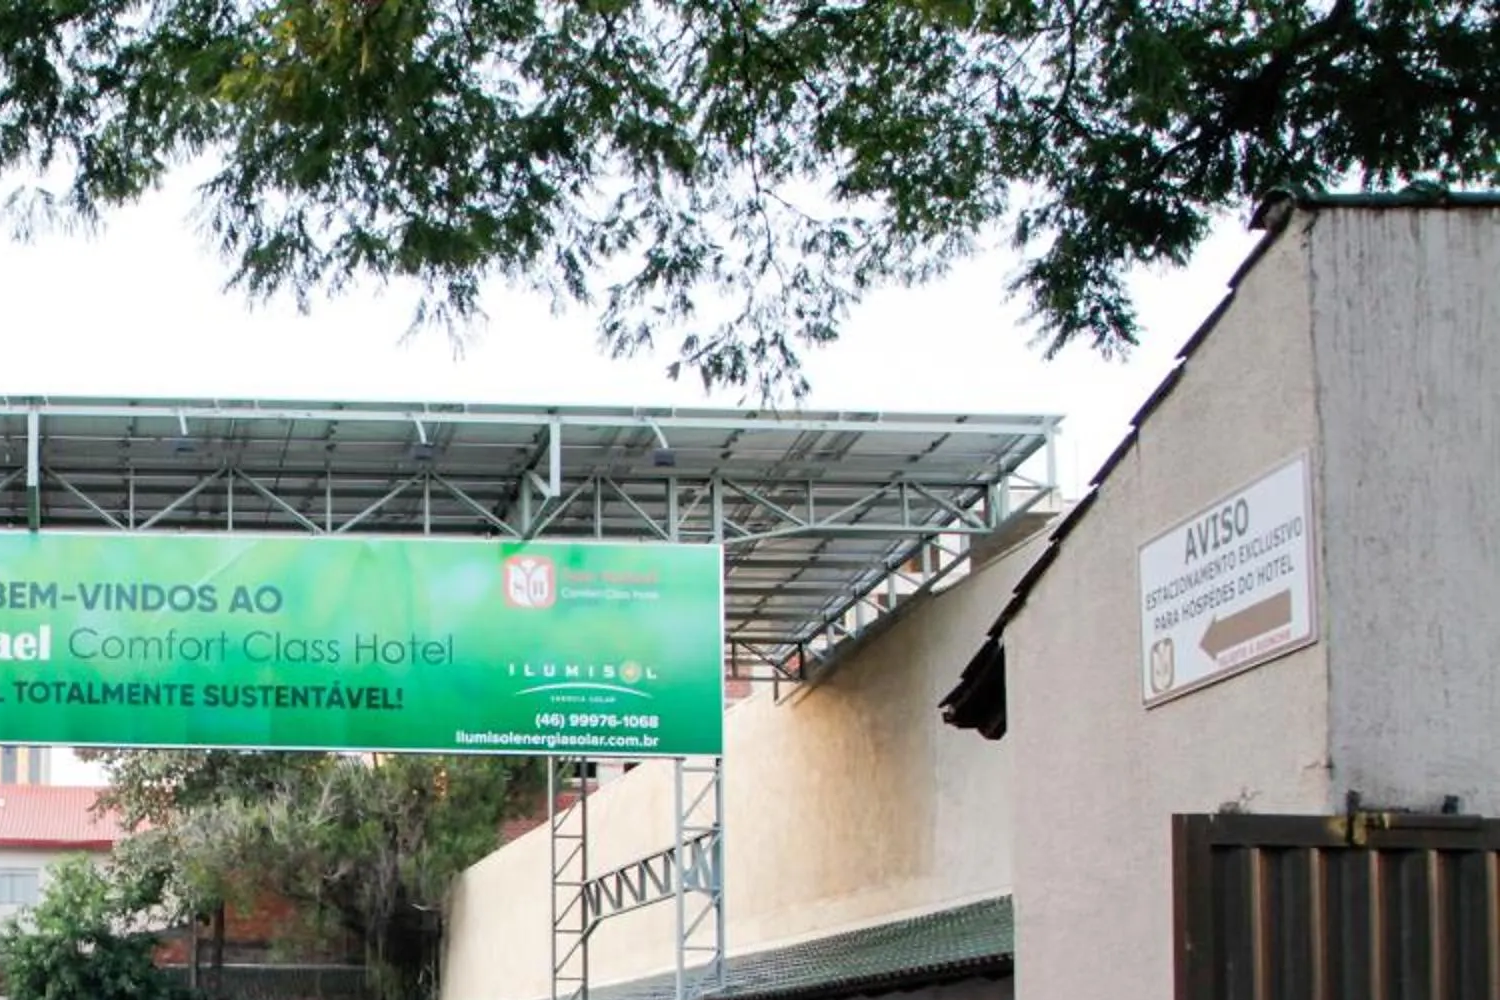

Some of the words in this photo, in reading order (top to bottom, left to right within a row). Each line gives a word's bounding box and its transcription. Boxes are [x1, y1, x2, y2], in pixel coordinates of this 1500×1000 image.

[1185, 498, 1249, 564] AVISO
[1145, 551, 1237, 611] ESTACIONAMENTO
[1239, 516, 1302, 565] EXCLUSIVO
[1237, 572, 1254, 595] DO
[1257, 553, 1294, 587] HOTEL
[228, 585, 283, 614] AO
[68, 626, 228, 663] Comfort
[243, 630, 340, 664] Class
[355, 633, 454, 665] Hotel
[509, 660, 657, 683] ILUMISOL
[14, 682, 194, 707] TOTALMENTE
[203, 681, 404, 710] SUSTENTÁVEL!
[535, 713, 565, 729] (46)
